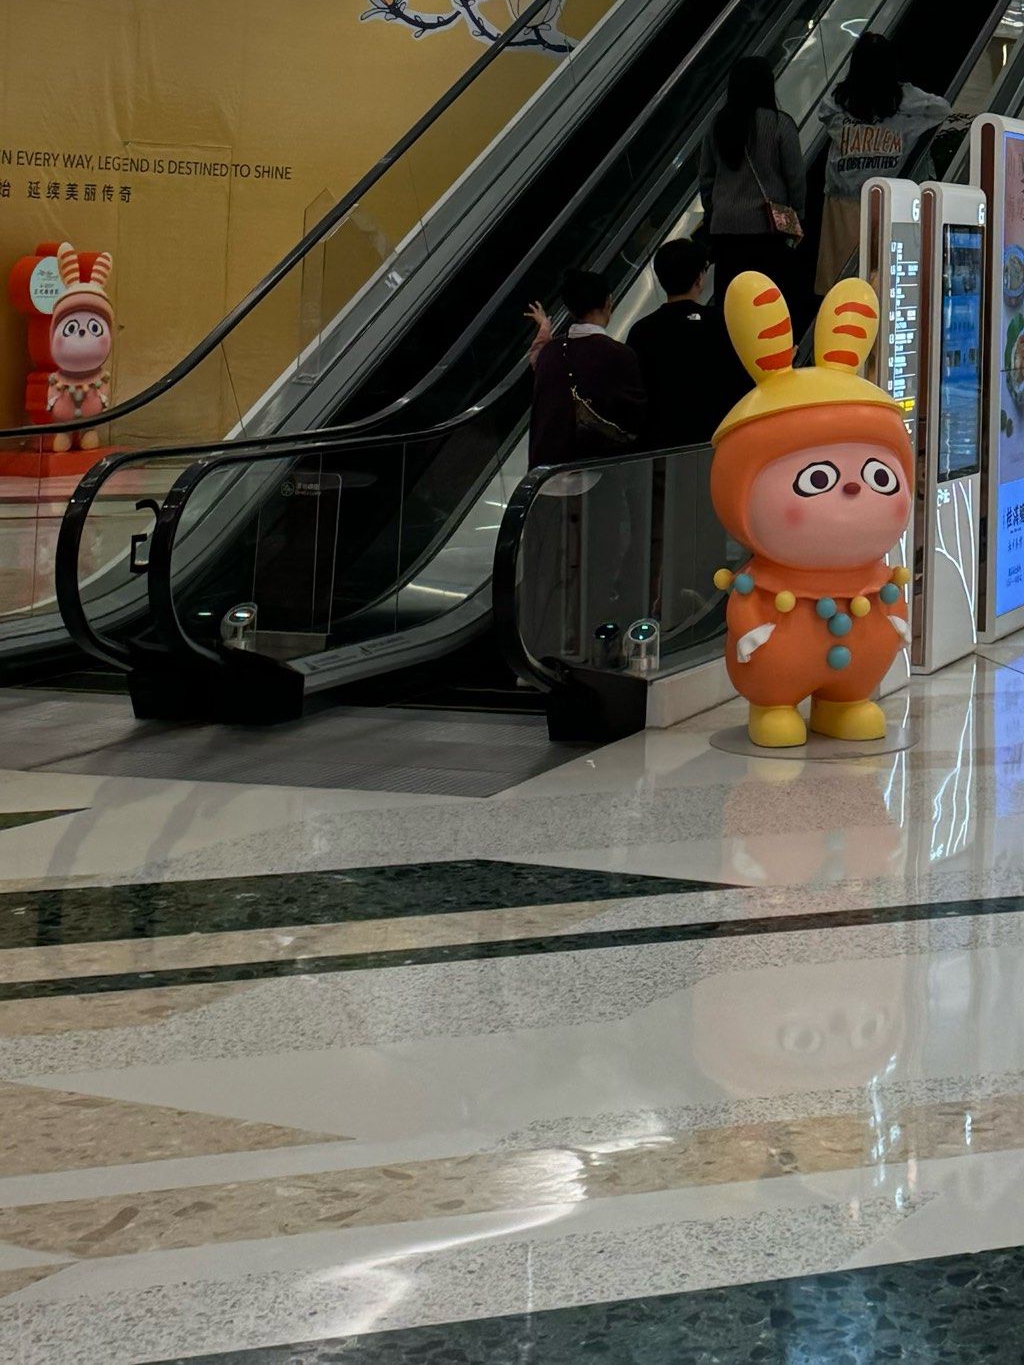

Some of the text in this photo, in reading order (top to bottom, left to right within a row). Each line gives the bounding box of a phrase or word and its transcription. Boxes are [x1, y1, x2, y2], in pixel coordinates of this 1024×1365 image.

[841, 126, 901, 156] HARLEM
[0, 149, 293, 180] N EVERY WAY, LEGEND IS DESTINED TO SHINE
[27, 181, 132, 204] 延续美丽传奇
